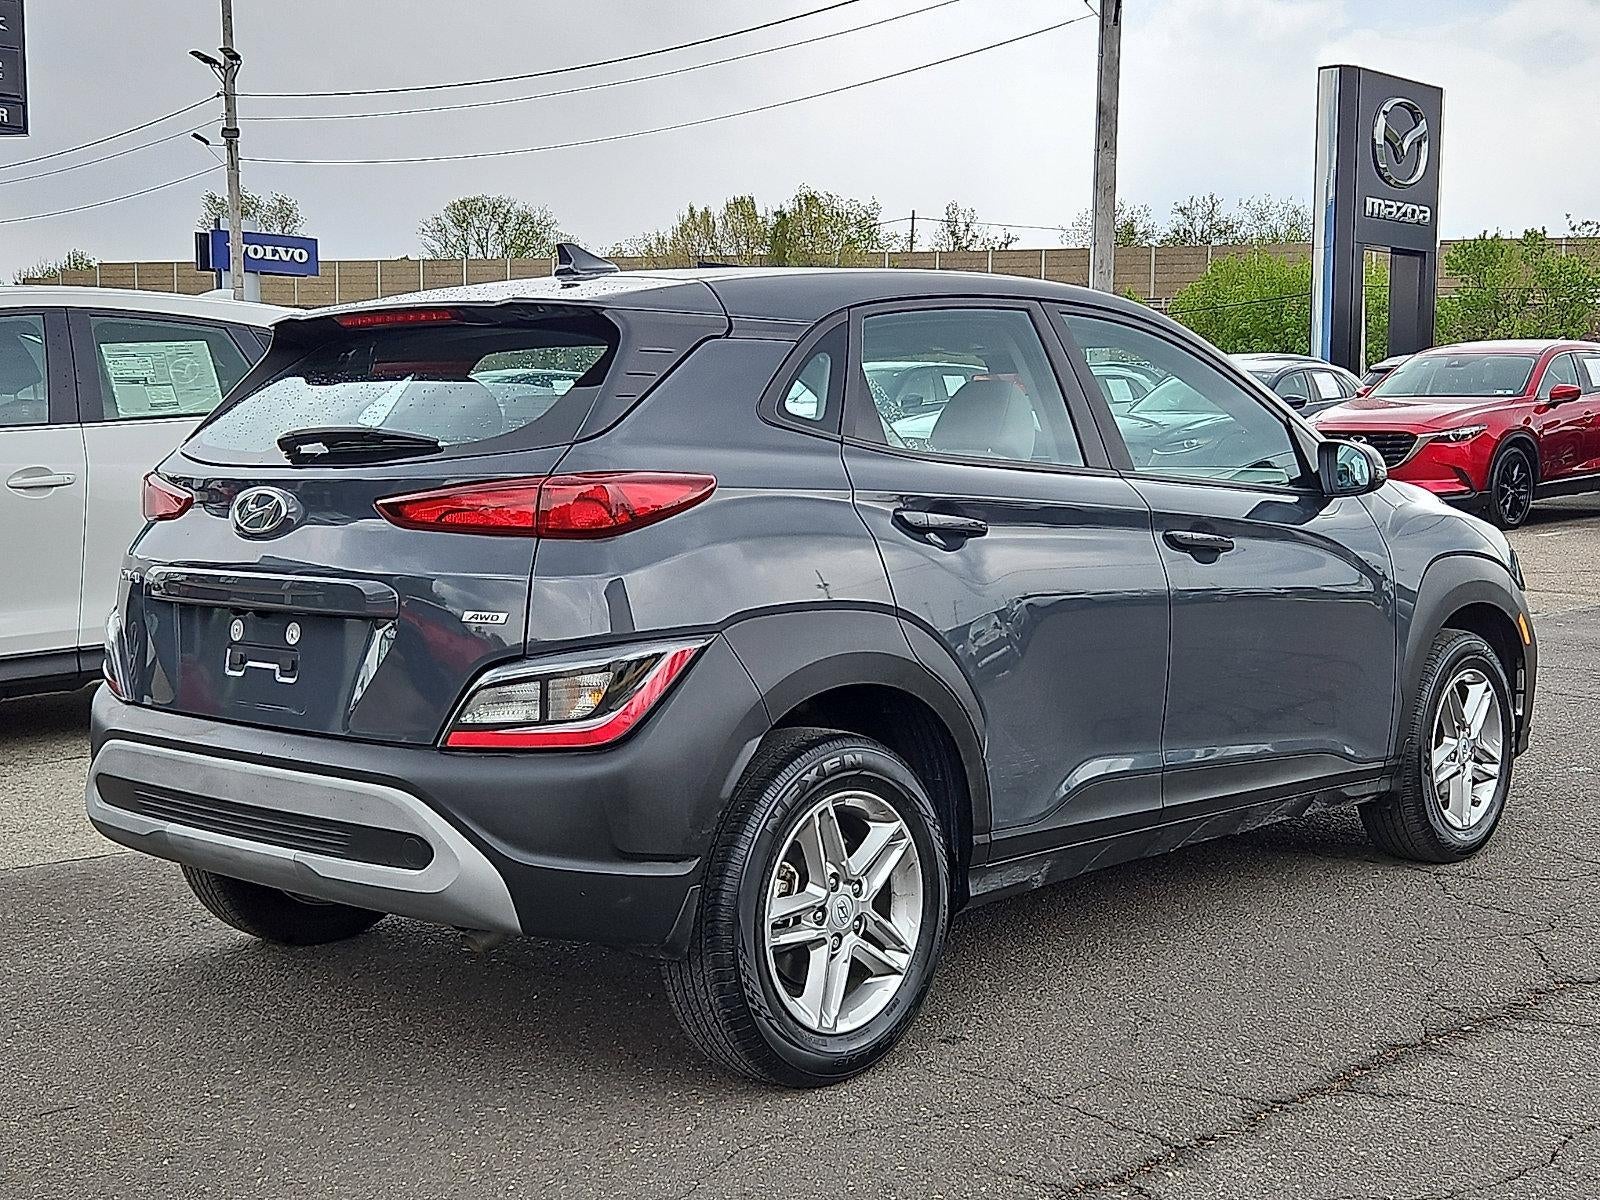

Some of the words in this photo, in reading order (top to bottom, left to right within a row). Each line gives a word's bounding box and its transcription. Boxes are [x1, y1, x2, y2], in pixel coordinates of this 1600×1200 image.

[226, 243, 309, 263] OLVO
[468, 613, 500, 622] AWD
[765, 754, 863, 835] NEXEN
